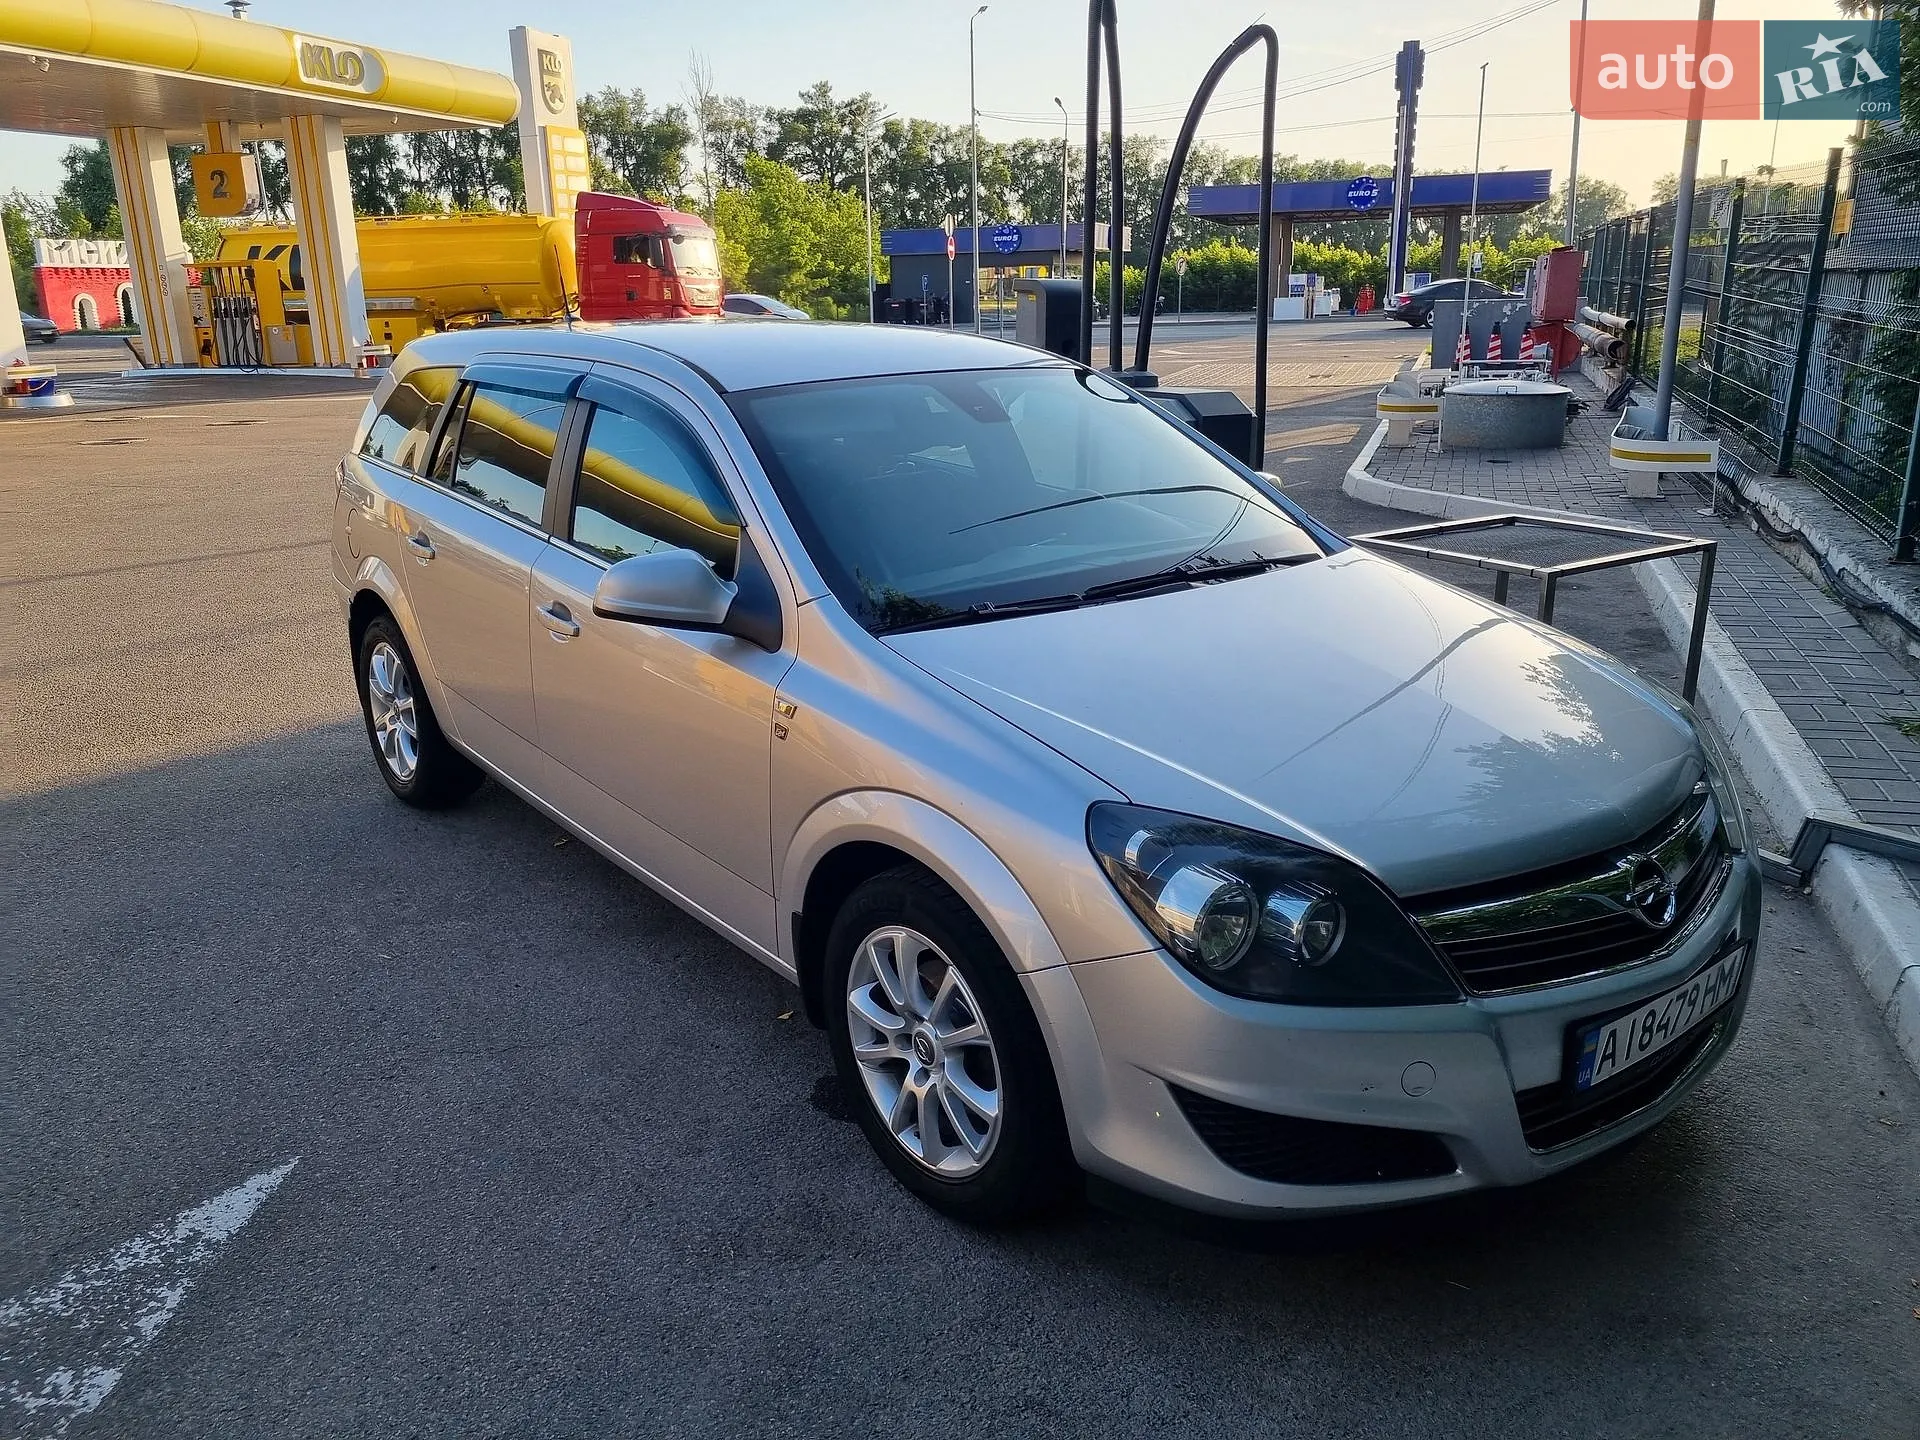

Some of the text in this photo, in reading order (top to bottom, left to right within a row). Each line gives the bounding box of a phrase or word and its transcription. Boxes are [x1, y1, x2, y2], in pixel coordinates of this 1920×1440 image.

[300, 42, 365, 86] KLO
[542, 53, 562, 73] KLO
[210, 169, 231, 199] 2
[1371, 189, 1379, 197] 5
[1012, 234, 1019, 242] 5
[1577, 1068, 1591, 1084] UA
